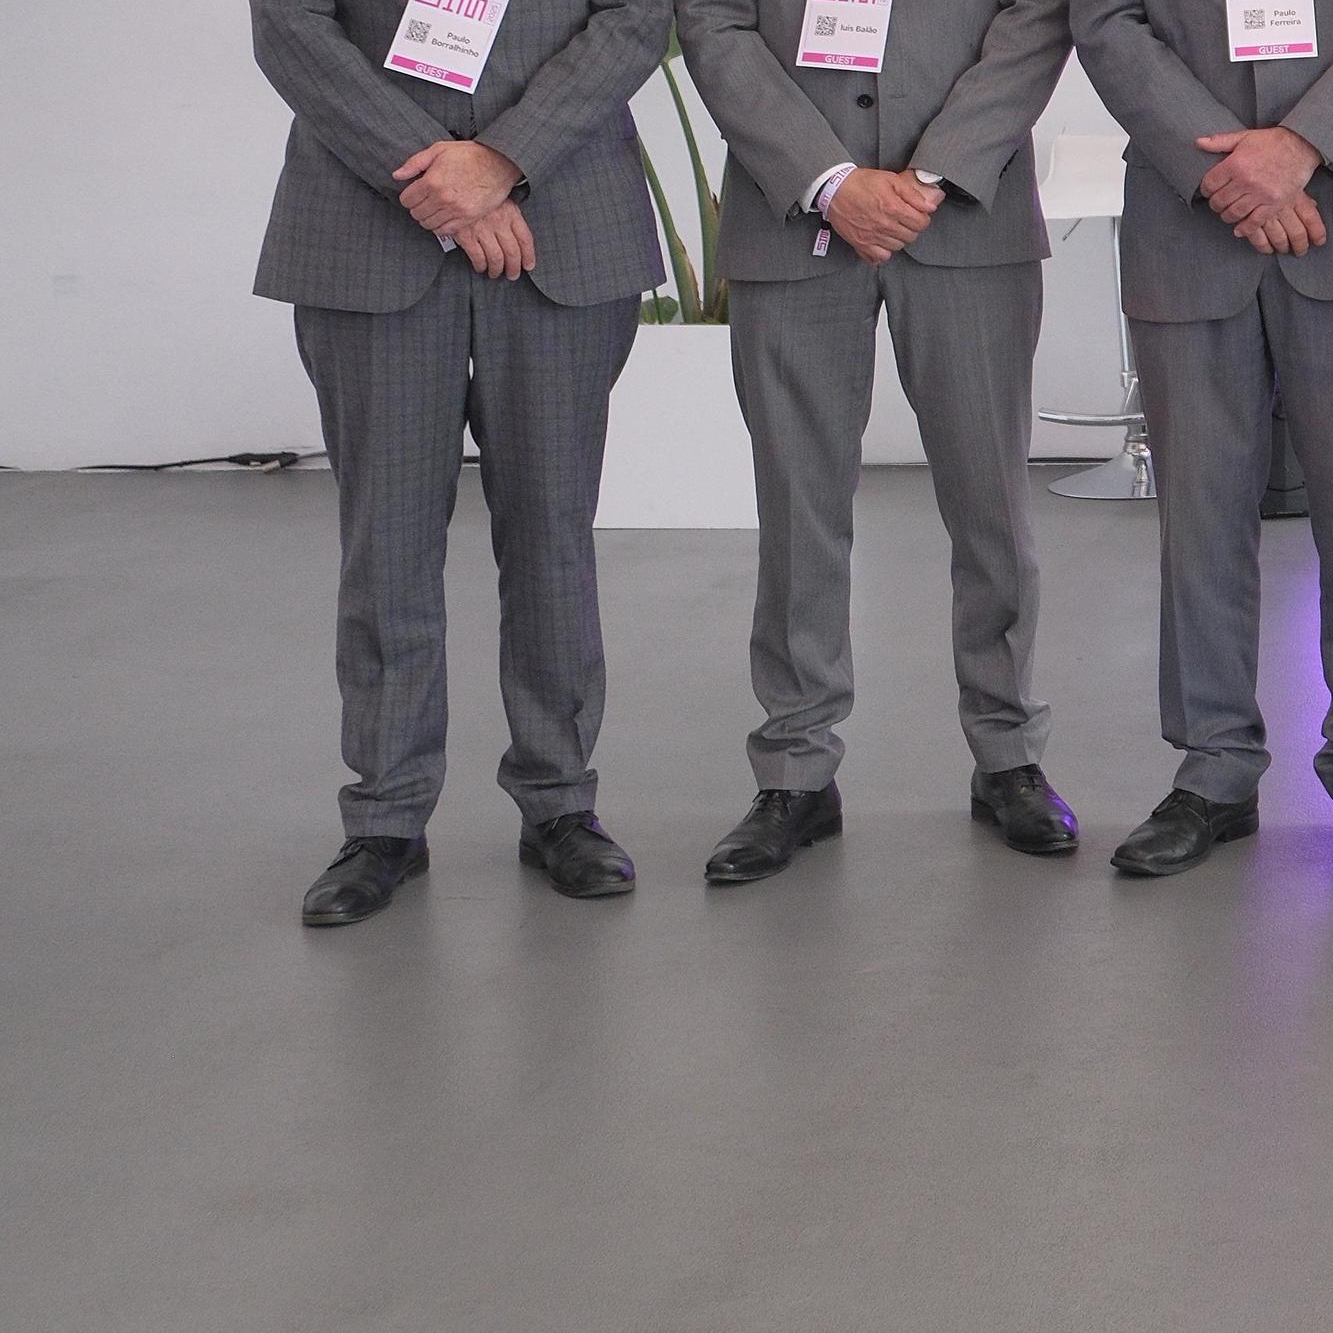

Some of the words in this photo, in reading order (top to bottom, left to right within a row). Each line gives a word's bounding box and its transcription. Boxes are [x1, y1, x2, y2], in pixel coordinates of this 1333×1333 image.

[447, 32, 471, 45] Paulo
[1259, 45, 1290, 54] GUEST
[824, 55, 856, 65] GUEST
[415, 64, 449, 79] GUEST
